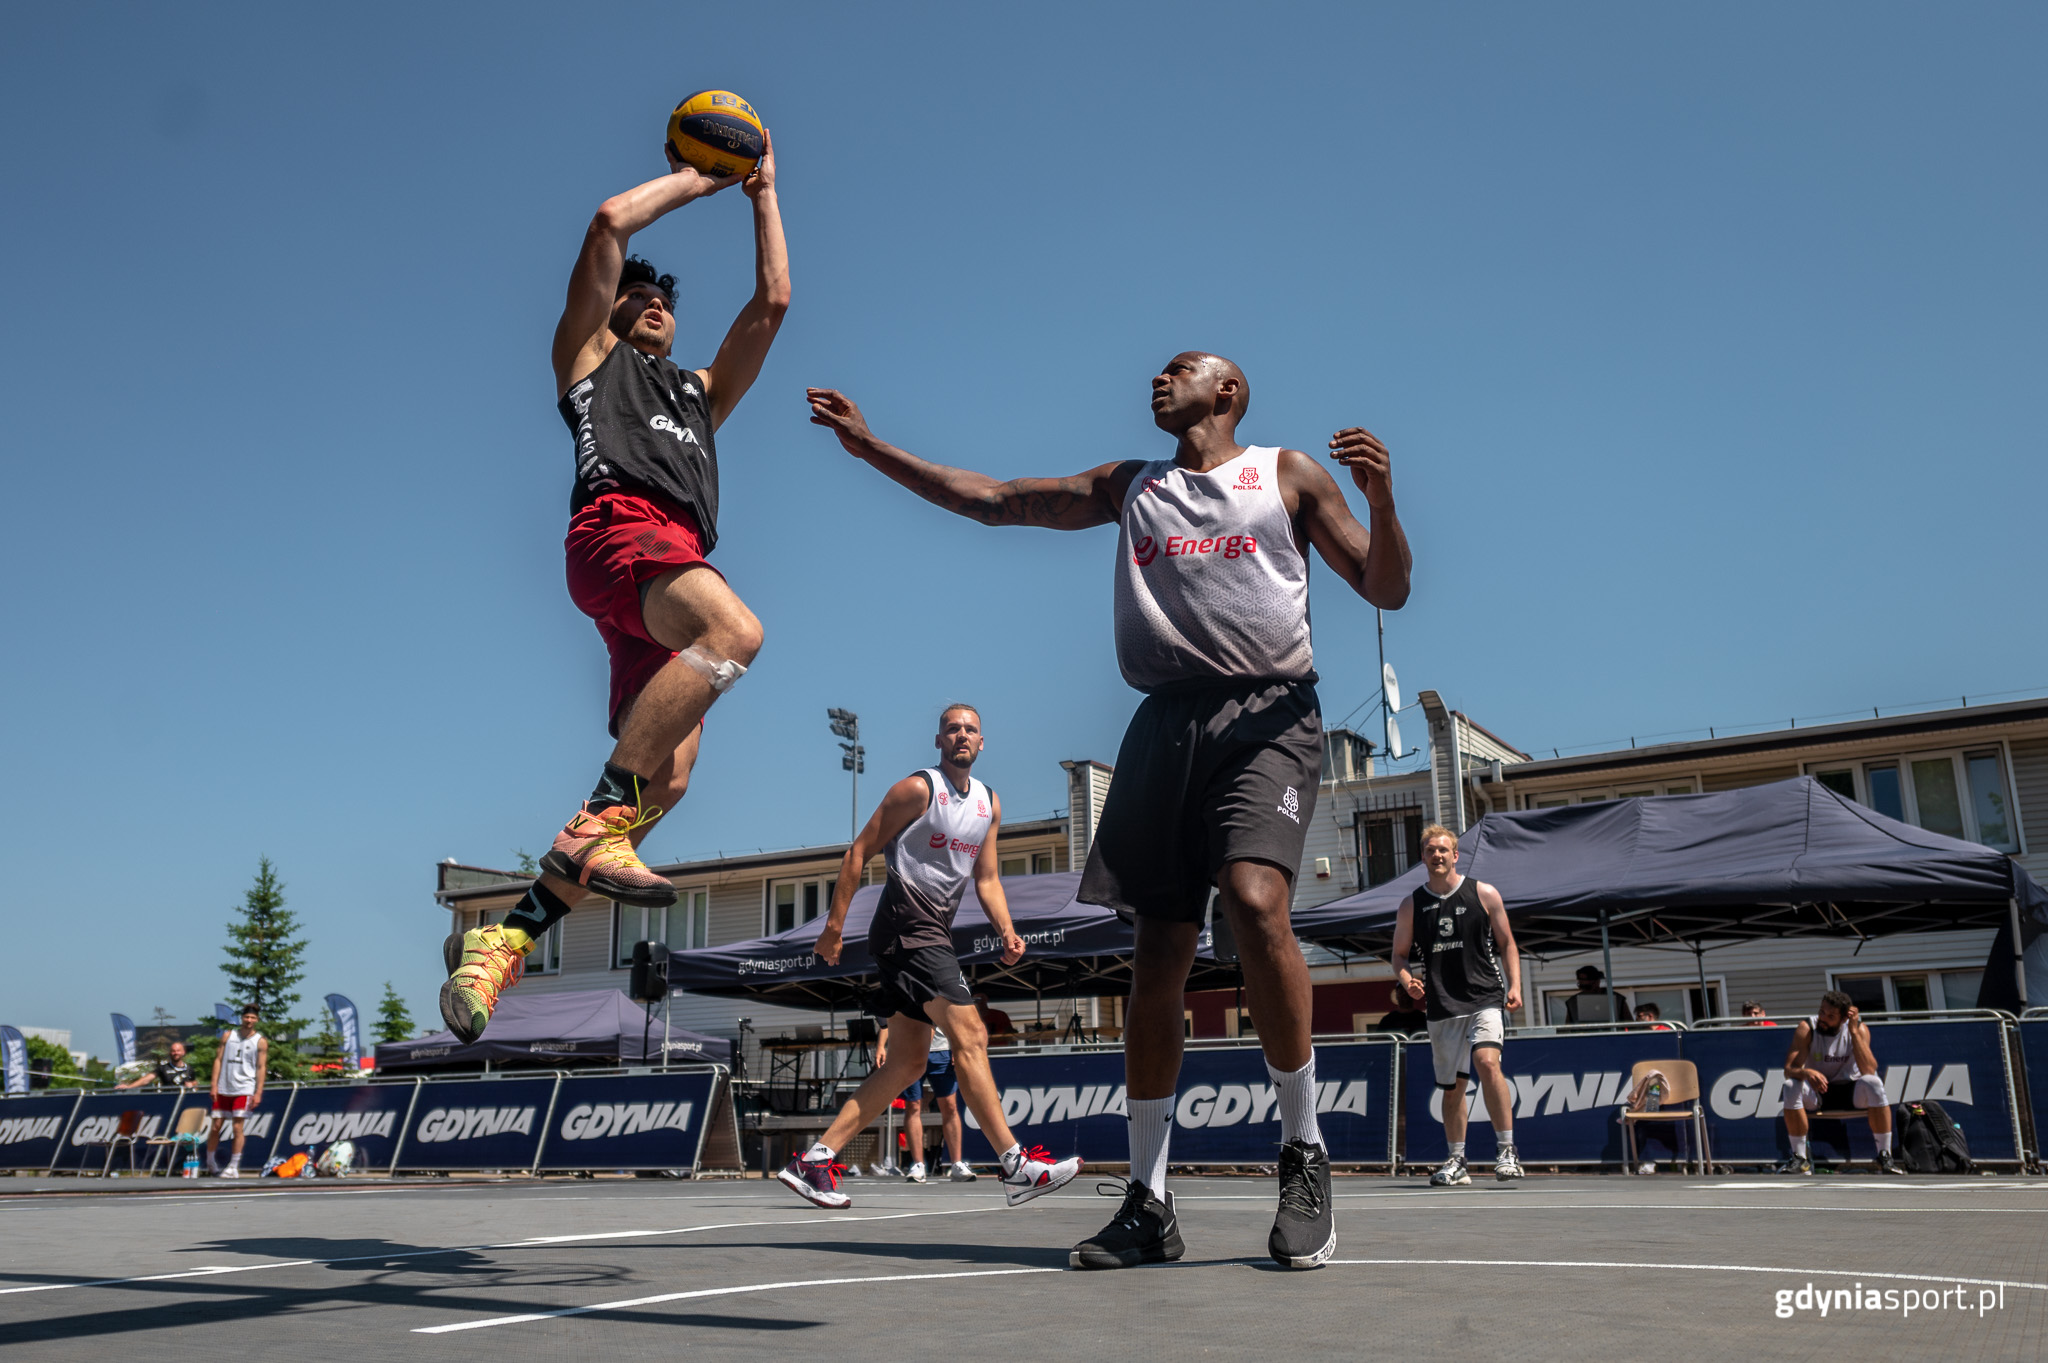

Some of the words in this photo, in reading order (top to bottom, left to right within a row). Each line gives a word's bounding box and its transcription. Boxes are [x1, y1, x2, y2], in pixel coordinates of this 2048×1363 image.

[1232, 484, 1263, 492] POLSKA
[1164, 535, 1257, 560] Energa
[1277, 805, 1300, 825] POLSKA
[973, 928, 1065, 953] gdynport.pl
[1439, 917, 1455, 938] 3
[738, 953, 817, 975] gdyniasport.pl
[1176, 1081, 1368, 1130] GDYIA
[0, 1116, 62, 1145] DYNIA
[72, 1115, 161, 1146] GDYIA
[290, 1111, 396, 1146] GDYNIA
[417, 1107, 536, 1142] GDYNIA
[561, 1103, 693, 1141] GDYNIA
